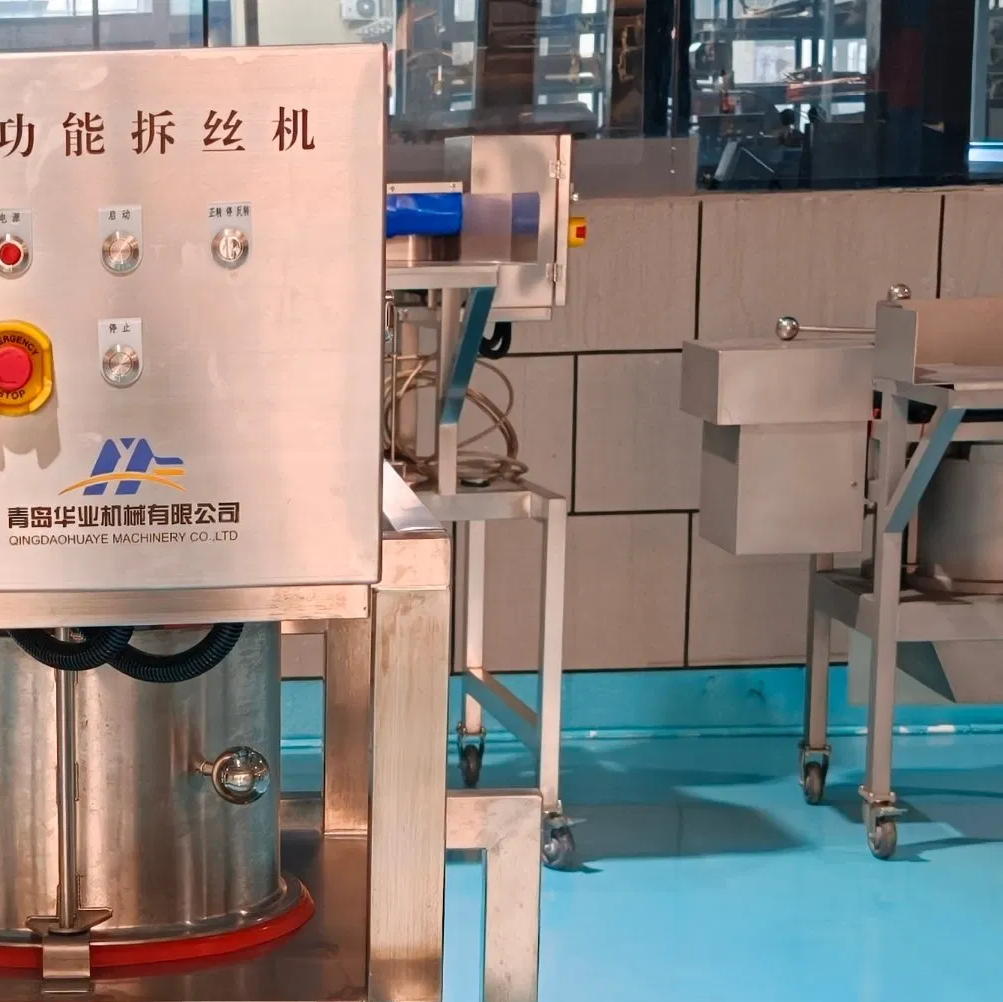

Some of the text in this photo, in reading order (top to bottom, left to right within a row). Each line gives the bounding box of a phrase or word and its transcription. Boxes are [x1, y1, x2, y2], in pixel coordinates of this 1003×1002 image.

[108, 208, 131, 221] 启动
[108, 321, 131, 334] 停止
[8, 502, 240, 529] 青岛华业机械有限公司
[9, 530, 238, 546] QINGDAOHUAYE MACHINERY CO.,LTD
